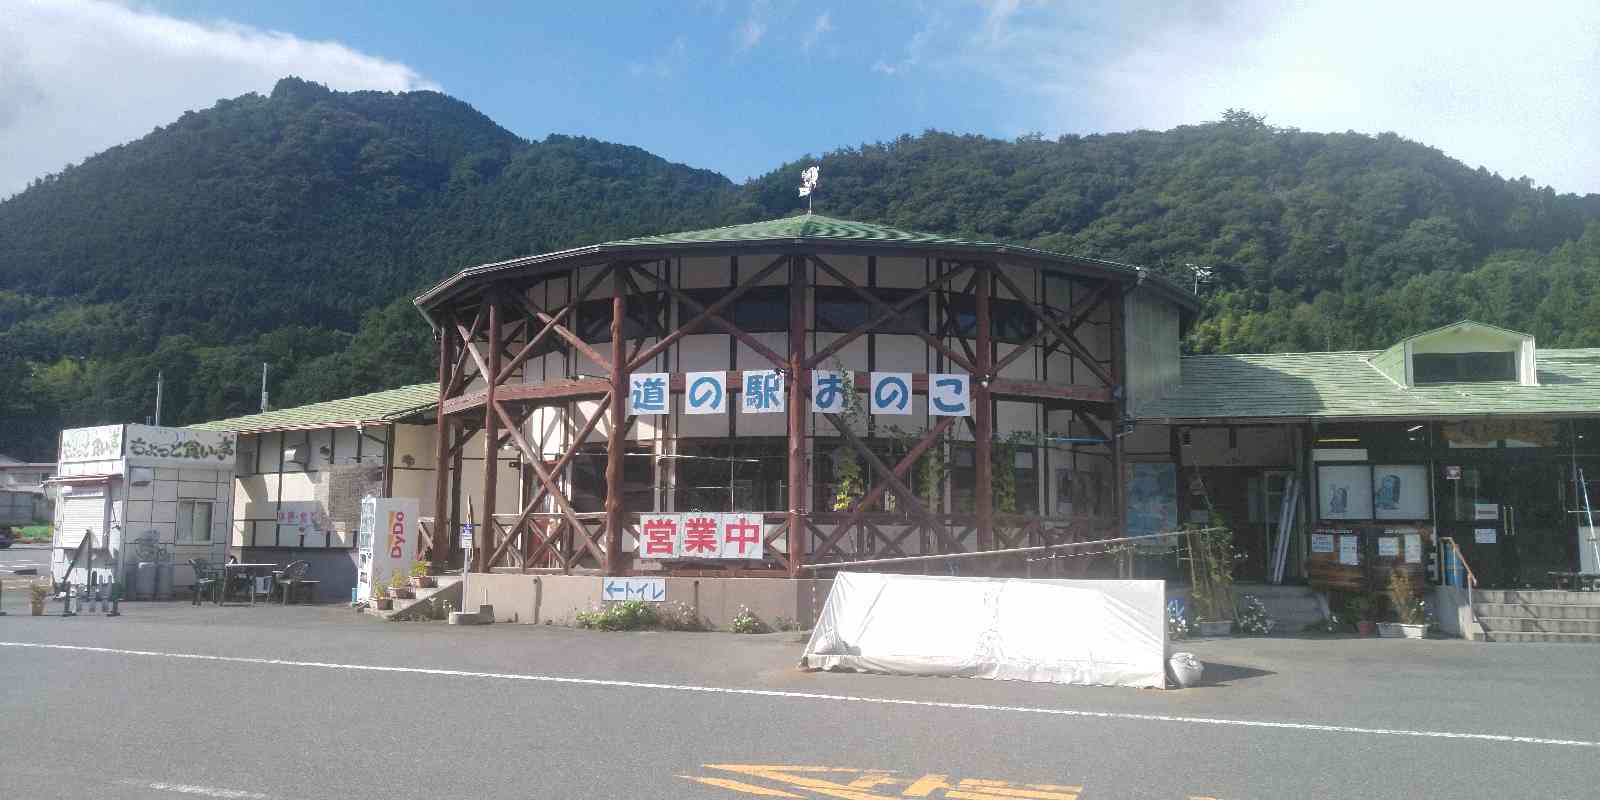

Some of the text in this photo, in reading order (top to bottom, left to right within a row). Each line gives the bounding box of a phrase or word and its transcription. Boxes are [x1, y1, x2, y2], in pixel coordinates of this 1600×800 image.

[391, 511, 405, 558] DyDo
[643, 517, 760, 555] 営業中
[626, 581, 664, 599] トイレ
